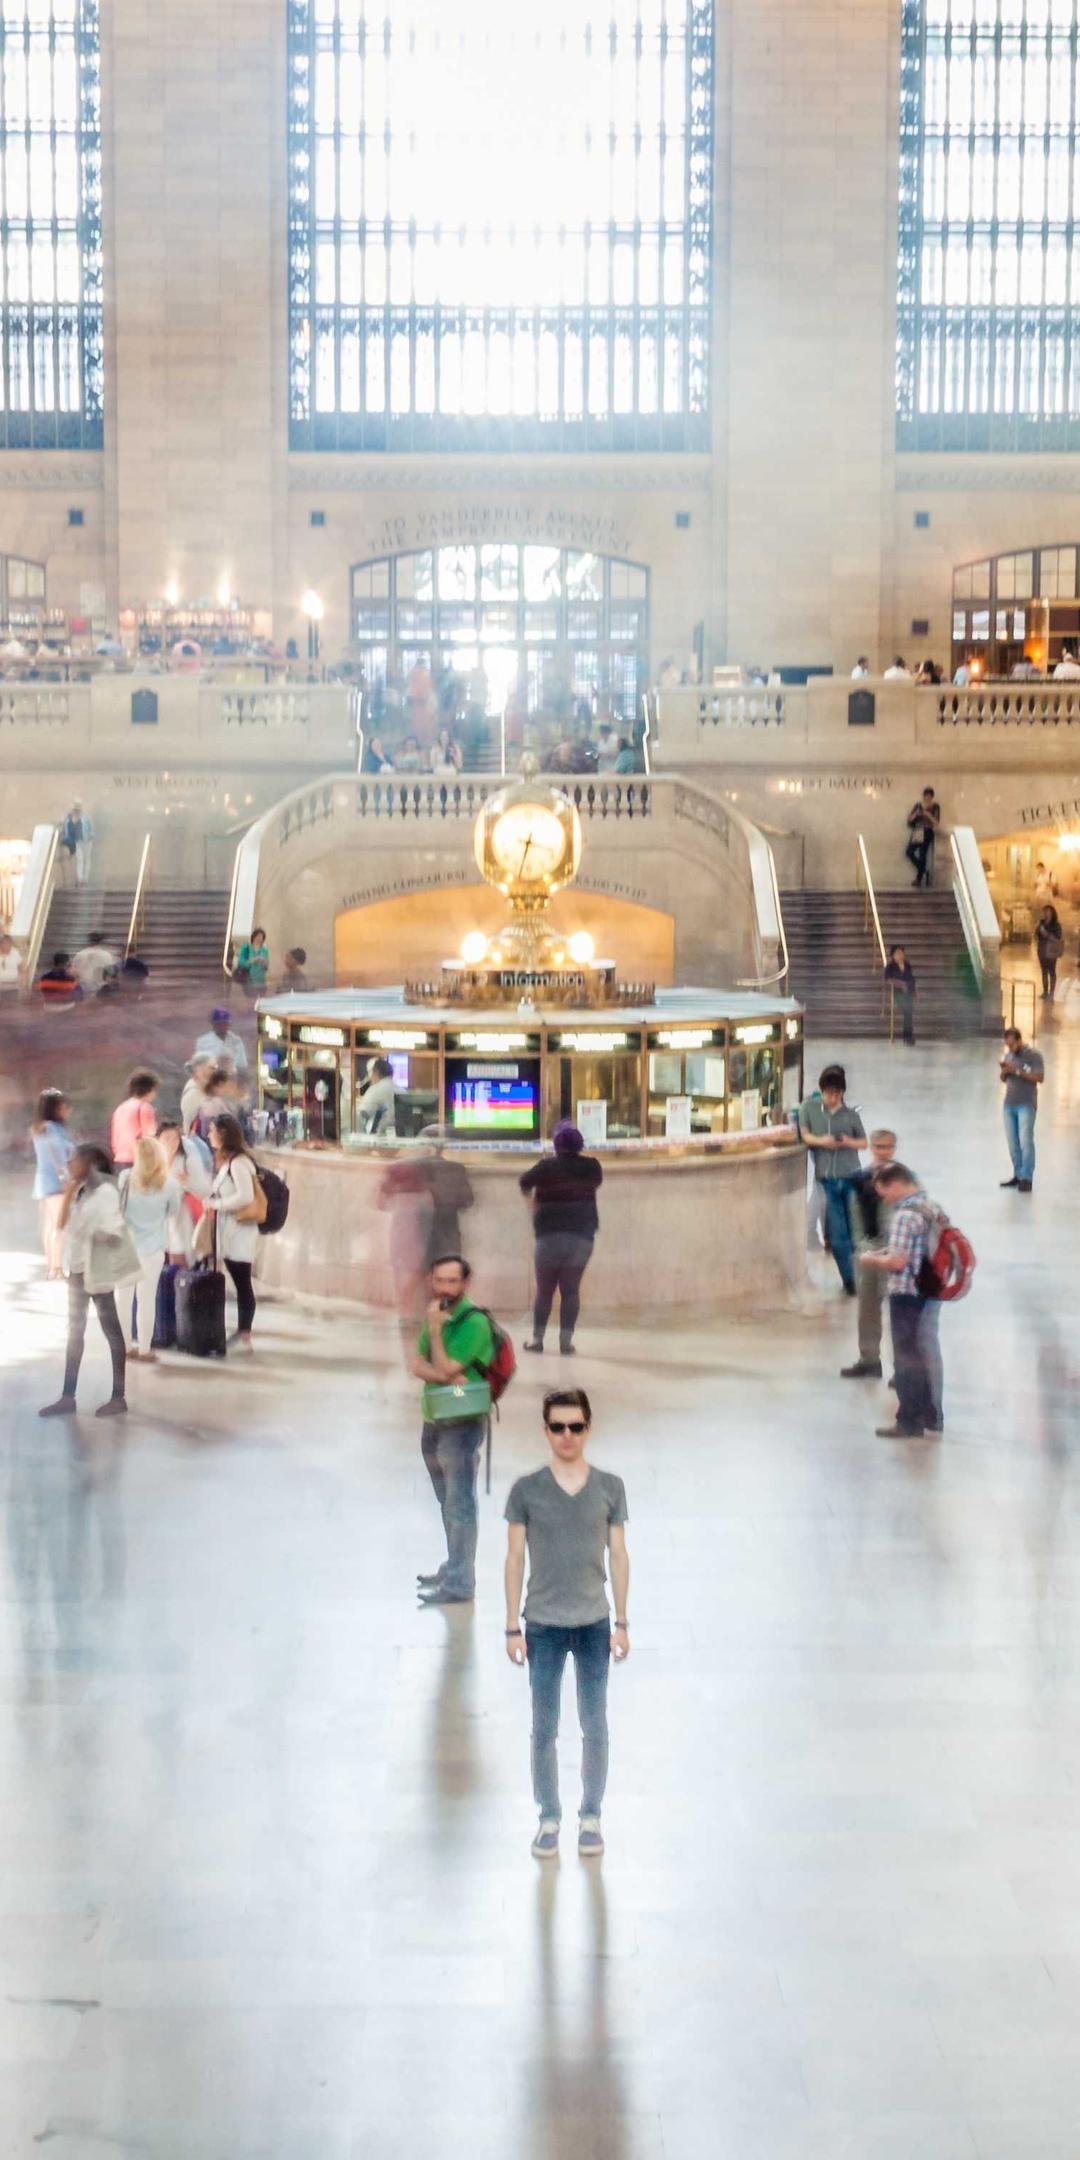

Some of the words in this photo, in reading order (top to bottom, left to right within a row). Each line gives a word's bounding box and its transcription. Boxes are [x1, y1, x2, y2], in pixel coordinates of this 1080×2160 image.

[381, 515, 406, 532] TO
[416, 507, 535, 526] VANDERBILT
[546, 510, 618, 532] AVENUE
[367, 534, 406, 551] THE
[112, 776, 149, 789] WEST
[828, 776, 895, 789] BALCONY
[342, 883, 391, 907] DINING
[393, 869, 467, 890] CONCOURSE
[500, 970, 585, 988] Information
